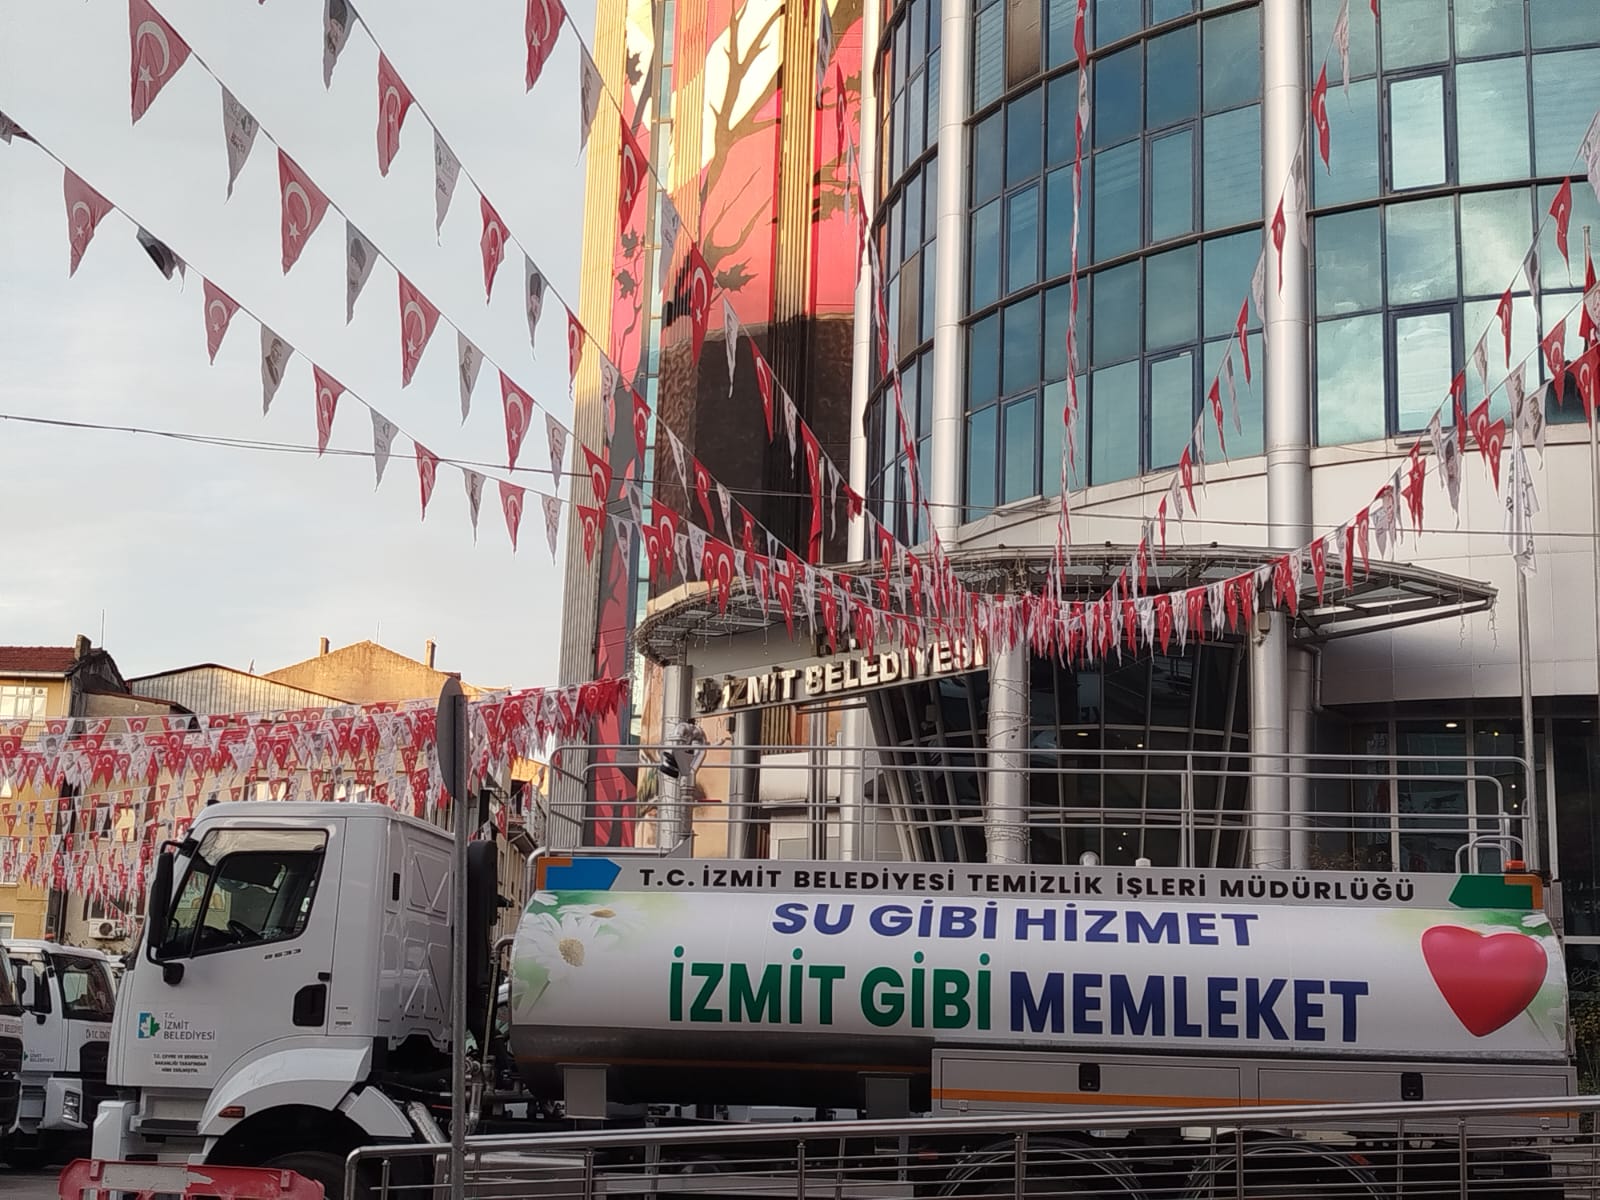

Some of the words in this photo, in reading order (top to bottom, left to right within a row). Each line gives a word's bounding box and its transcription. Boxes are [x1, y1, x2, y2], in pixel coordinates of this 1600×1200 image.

[639, 868, 695, 888] T.C.
[702, 865, 782, 889] İZMİT
[793, 866, 954, 892] BELEDİYESİ
[968, 871, 1103, 895] TEMİZLİK
[1116, 872, 1207, 899] İŞLERİ
[1219, 873, 1414, 902] MÜDÜRLÜĞÜ
[771, 902, 855, 936] SU
[869, 899, 998, 941] GİBİ
[1014, 902, 1259, 946] HİZMET
[669, 945, 846, 1026] İZMİT
[860, 951, 991, 1032] GİBİ
[1010, 971, 1369, 1043] MEMLEKET
[163, 1030, 215, 1041] BELEDİYESİ
[164, 1020, 190, 1030] İZMİT
